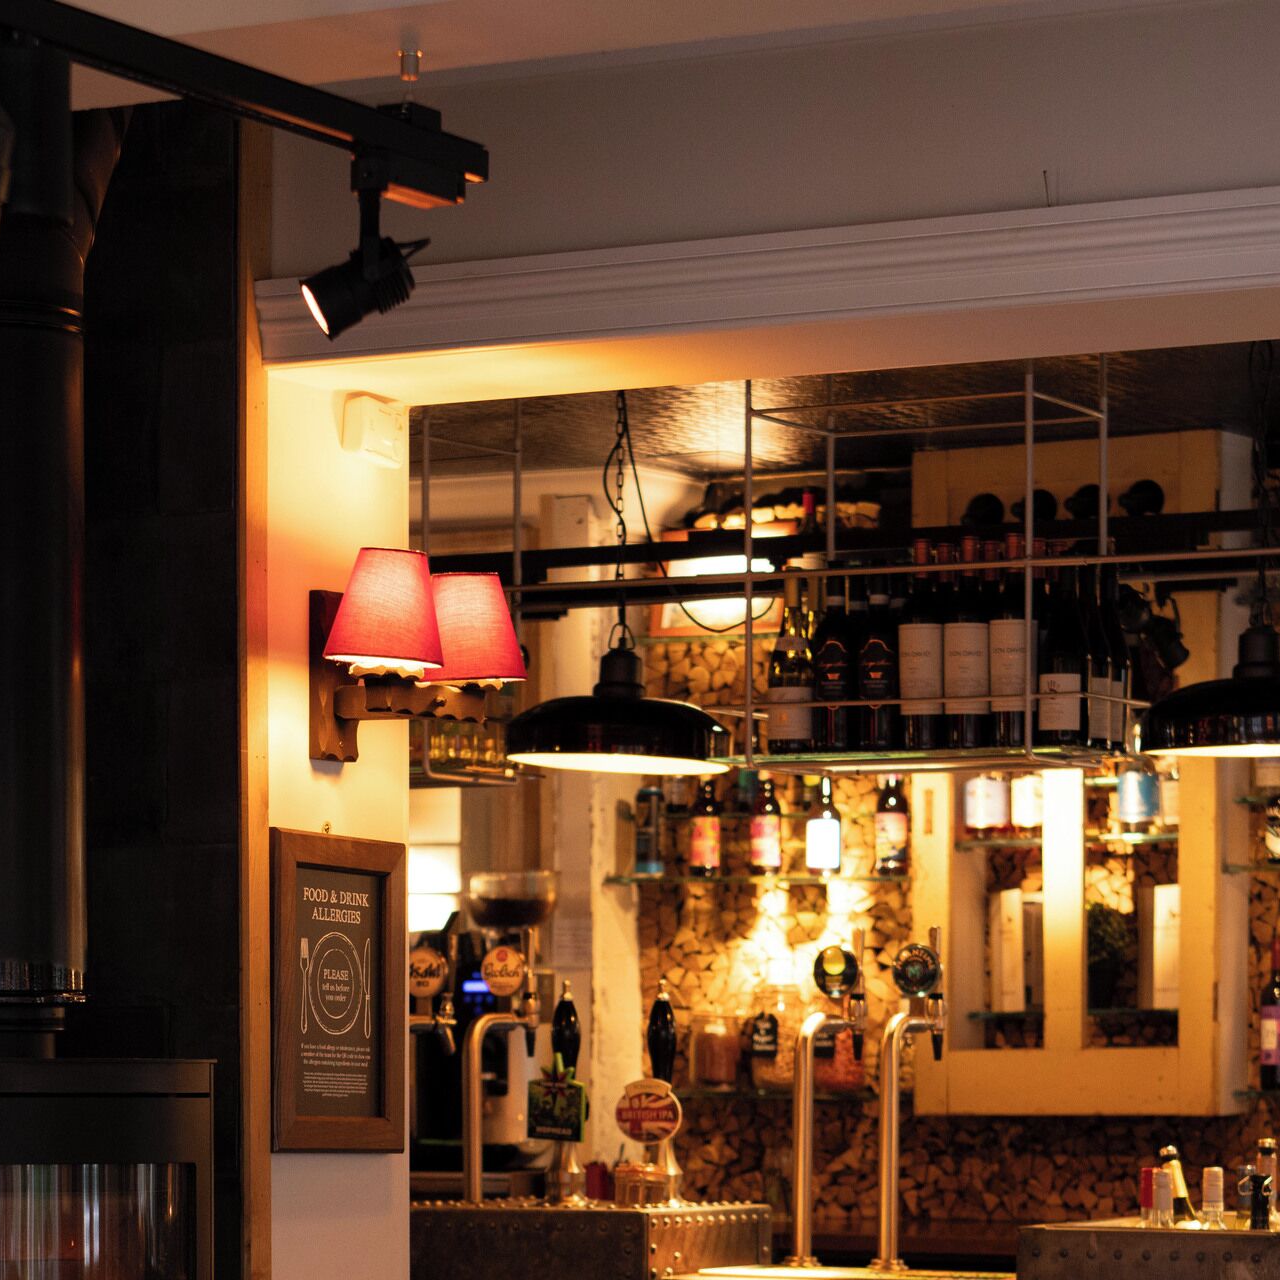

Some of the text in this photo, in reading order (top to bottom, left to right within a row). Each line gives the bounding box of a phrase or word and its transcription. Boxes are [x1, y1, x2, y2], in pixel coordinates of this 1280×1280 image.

[303, 887, 369, 907] FOOD & DRINK
[312, 907, 361, 924] ALLERGIES
[323, 968, 349, 981] PLEASE
[335, 983, 350, 993] before
[334, 994, 346, 1002] order
